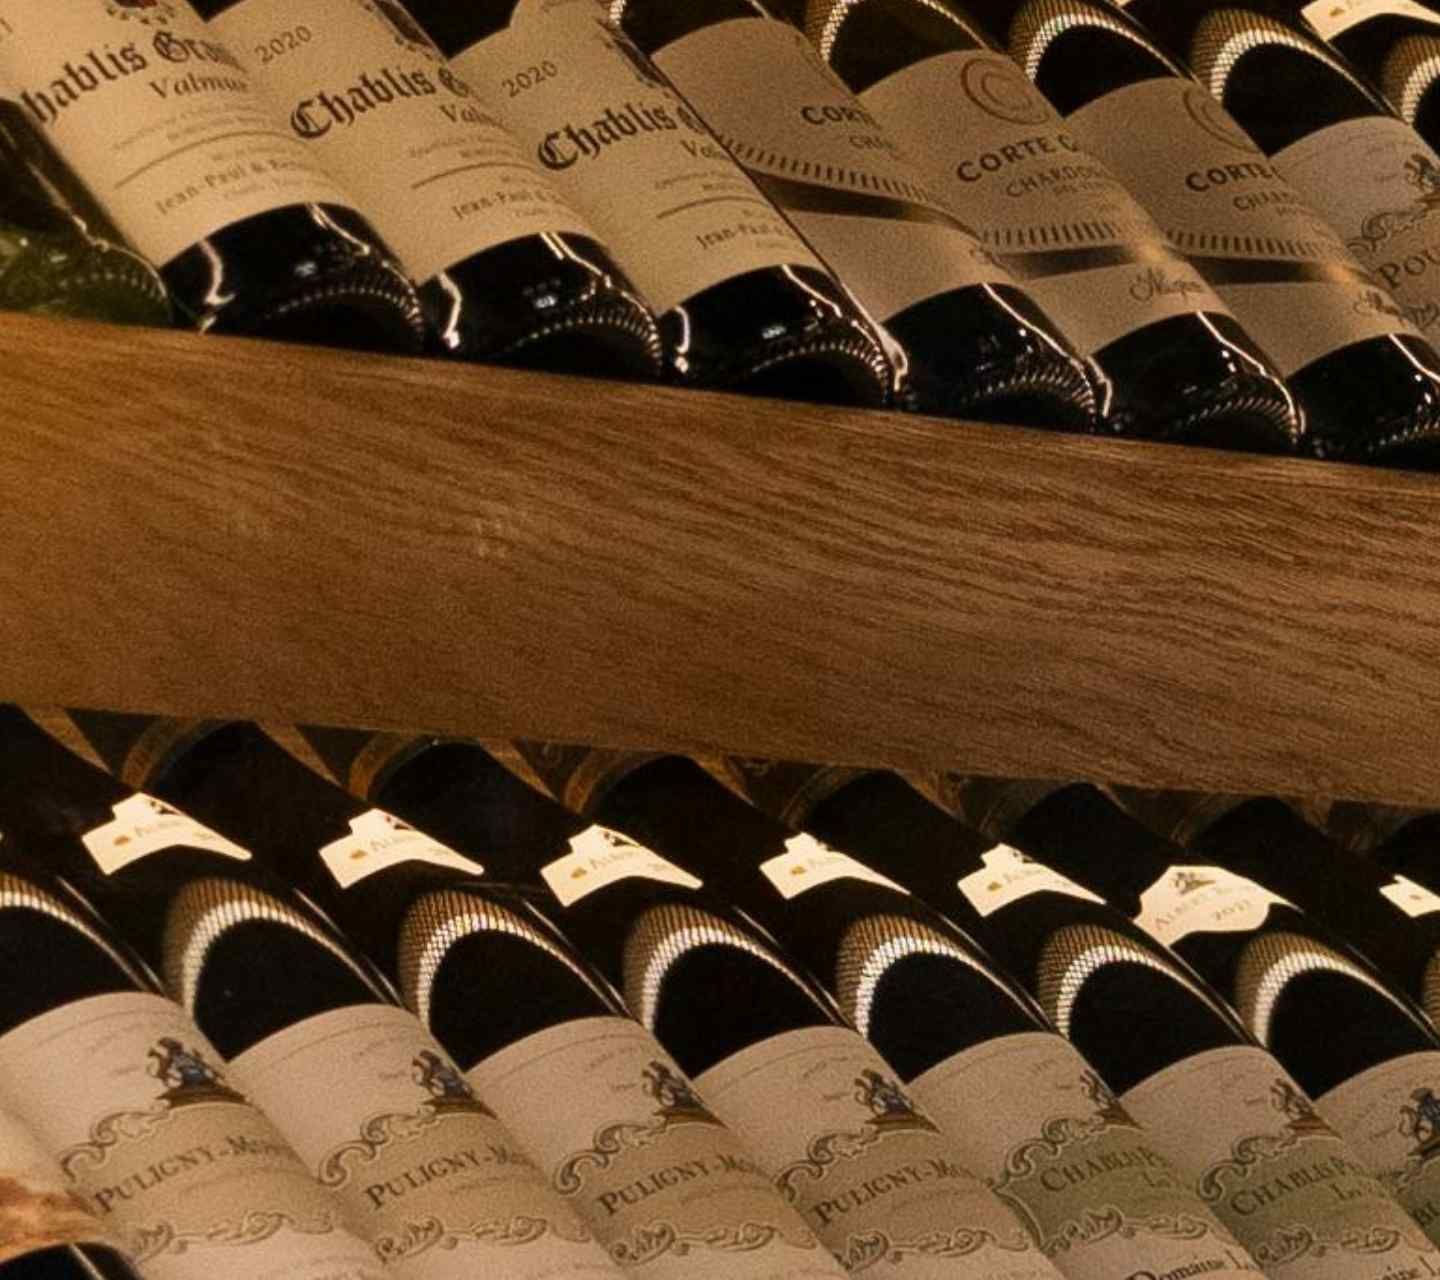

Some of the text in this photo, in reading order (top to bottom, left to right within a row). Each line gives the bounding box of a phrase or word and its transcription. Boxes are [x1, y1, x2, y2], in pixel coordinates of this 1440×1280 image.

[252, 22, 313, 66] 2020
[289, 65, 436, 140] Chablis
[501, 59, 559, 98] 2020
[537, 102, 678, 171] Chablis
[955, 134, 1051, 184] CORTE
